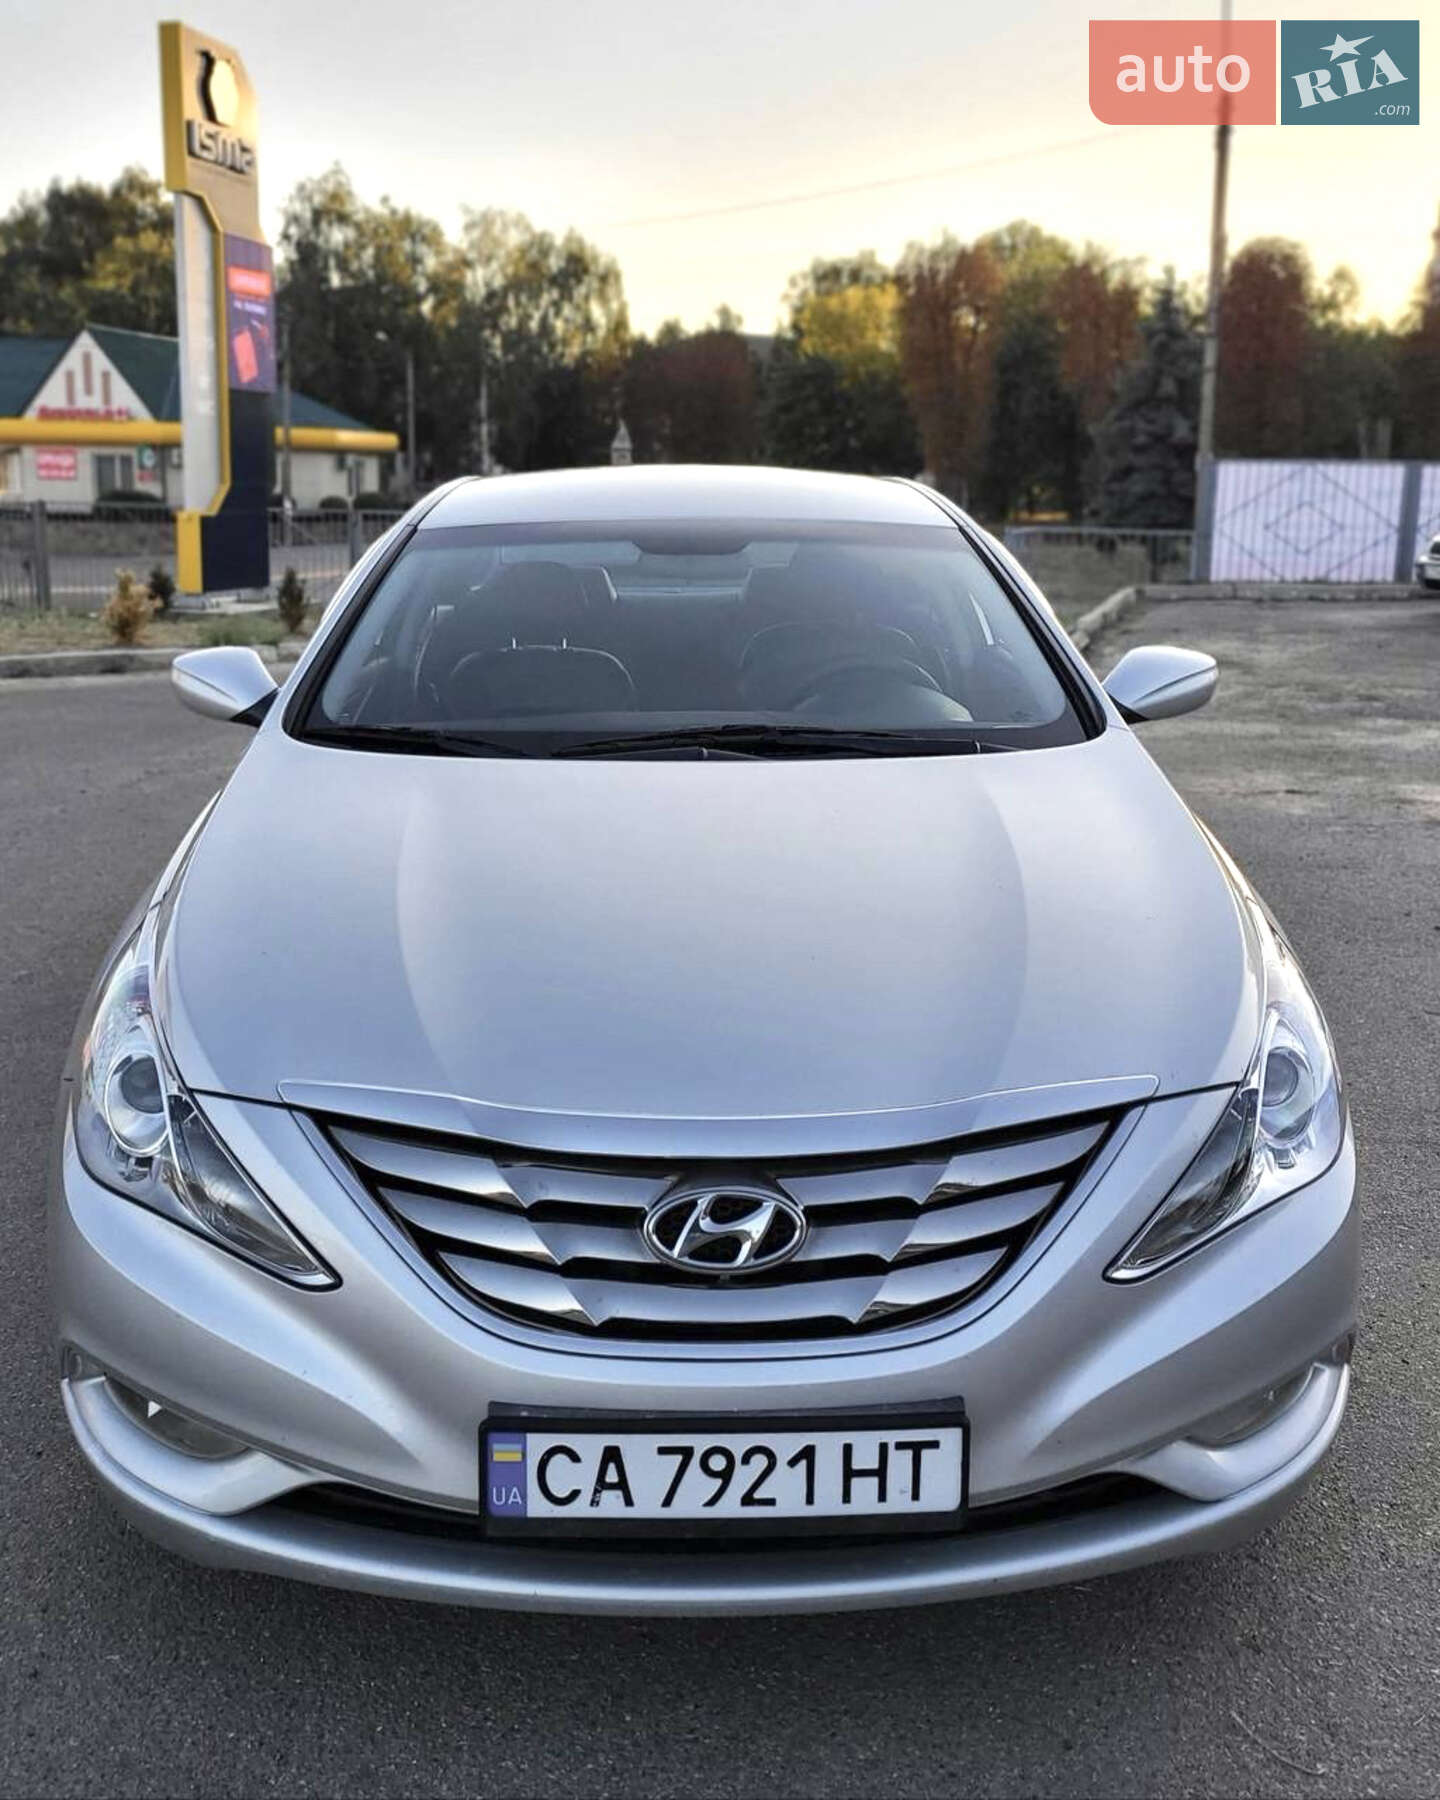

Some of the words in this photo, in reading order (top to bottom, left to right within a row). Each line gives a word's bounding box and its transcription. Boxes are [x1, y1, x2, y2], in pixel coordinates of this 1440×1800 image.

[536, 1444, 635, 1508] CA
[656, 1444, 817, 1508] 7921
[841, 1439, 942, 1505] HT
[491, 1486, 523, 1507] UA
